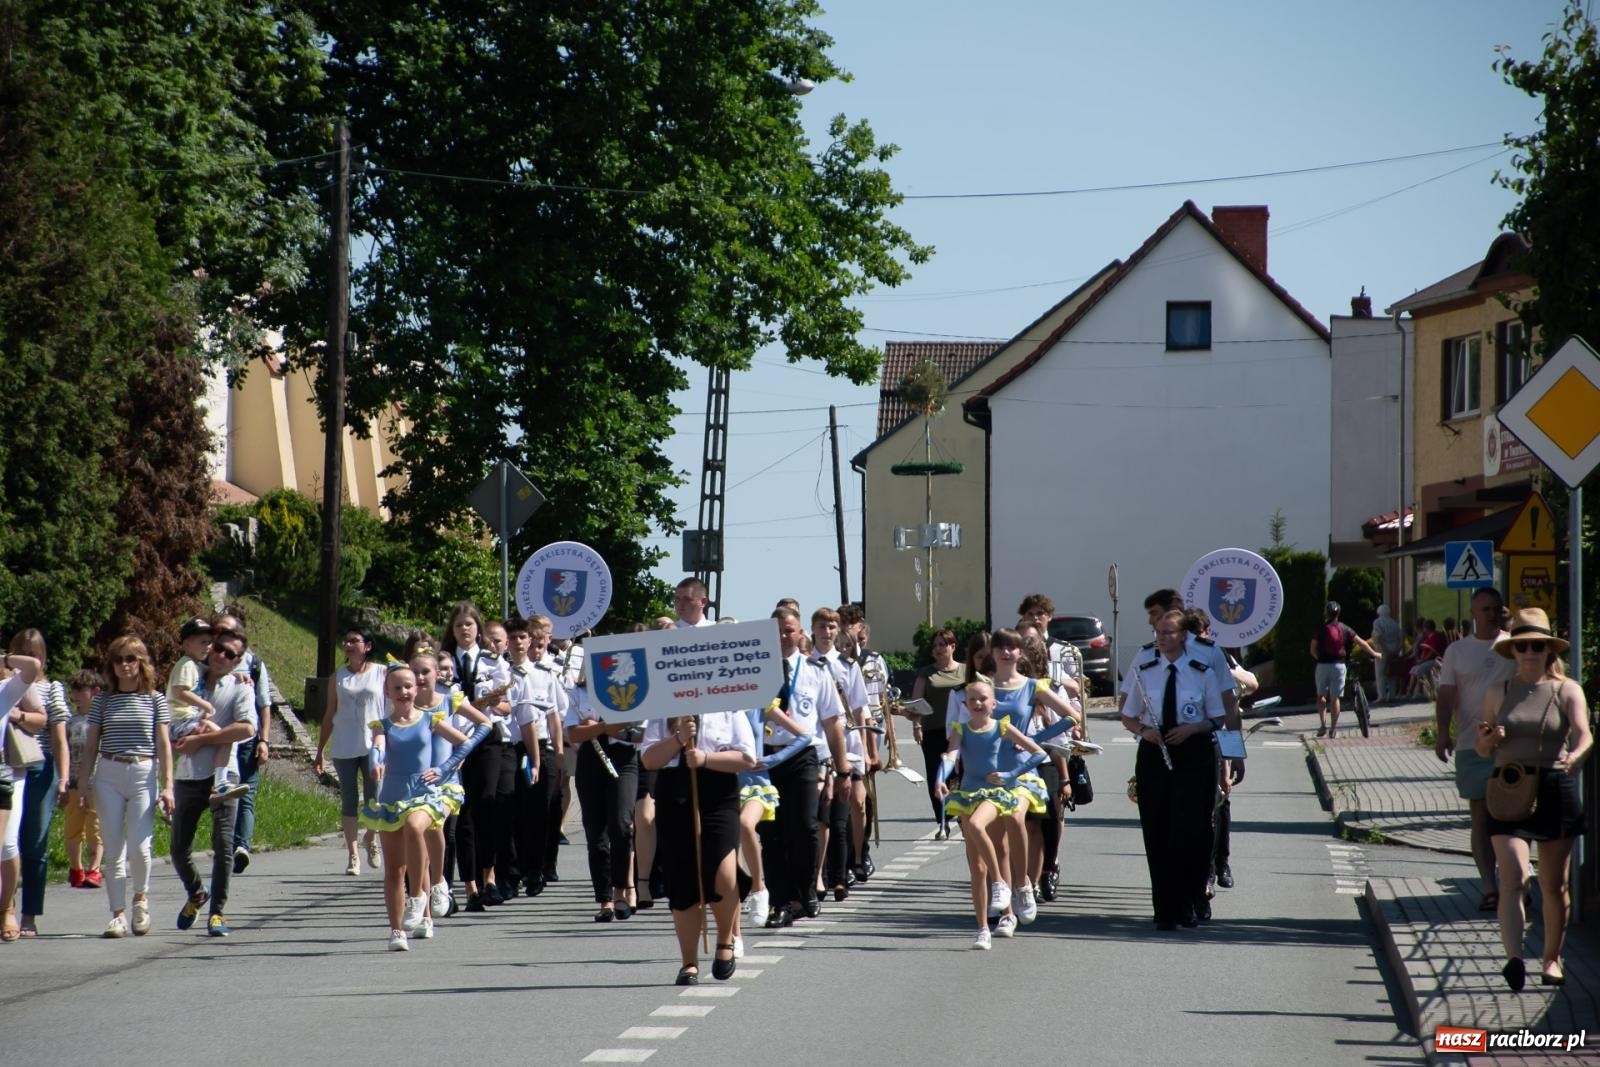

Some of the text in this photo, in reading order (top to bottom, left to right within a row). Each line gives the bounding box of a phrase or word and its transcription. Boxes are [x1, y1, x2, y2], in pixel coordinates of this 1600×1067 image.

[534, 548, 583, 567] ORKIESTRA
[596, 579, 607, 610] GMINY
[1198, 557, 1250, 575] ORKIESTRA
[1266, 586, 1278, 618] GMINY
[662, 638, 761, 656] Młodzieżowa
[655, 650, 771, 670] Orkiestra Dęta
[667, 666, 761, 682] Gminy Żytno
[673, 687, 704, 698] woj.
